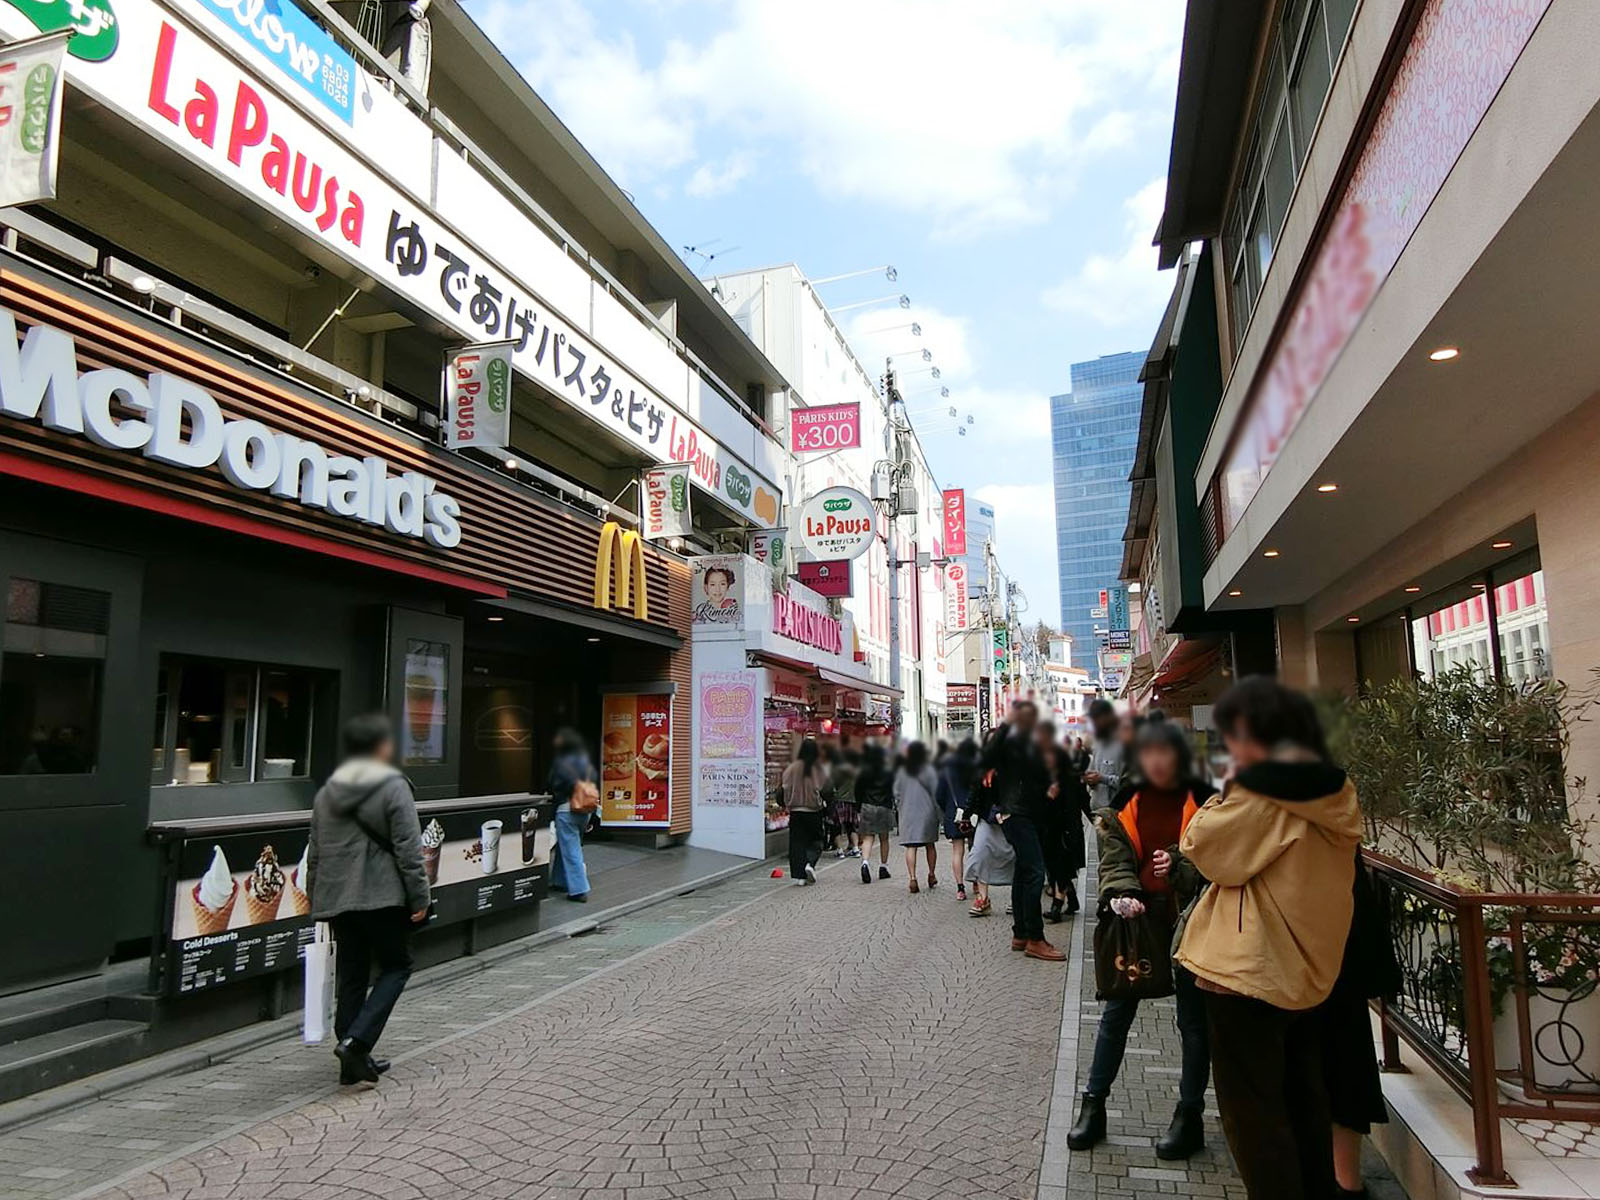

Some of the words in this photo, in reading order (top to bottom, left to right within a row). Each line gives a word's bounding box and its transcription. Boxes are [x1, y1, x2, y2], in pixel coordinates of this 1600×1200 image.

[0, 307, 461, 549] McDonald's
[799, 413, 826, 424] PARIS
[828, 410, 853, 421] KID'S
[797, 424, 853, 449] ¥300
[948, 593, 957, 628] SELECT
[183, 937, 203, 950] Cold
[204, 931, 239, 947] Desserts
